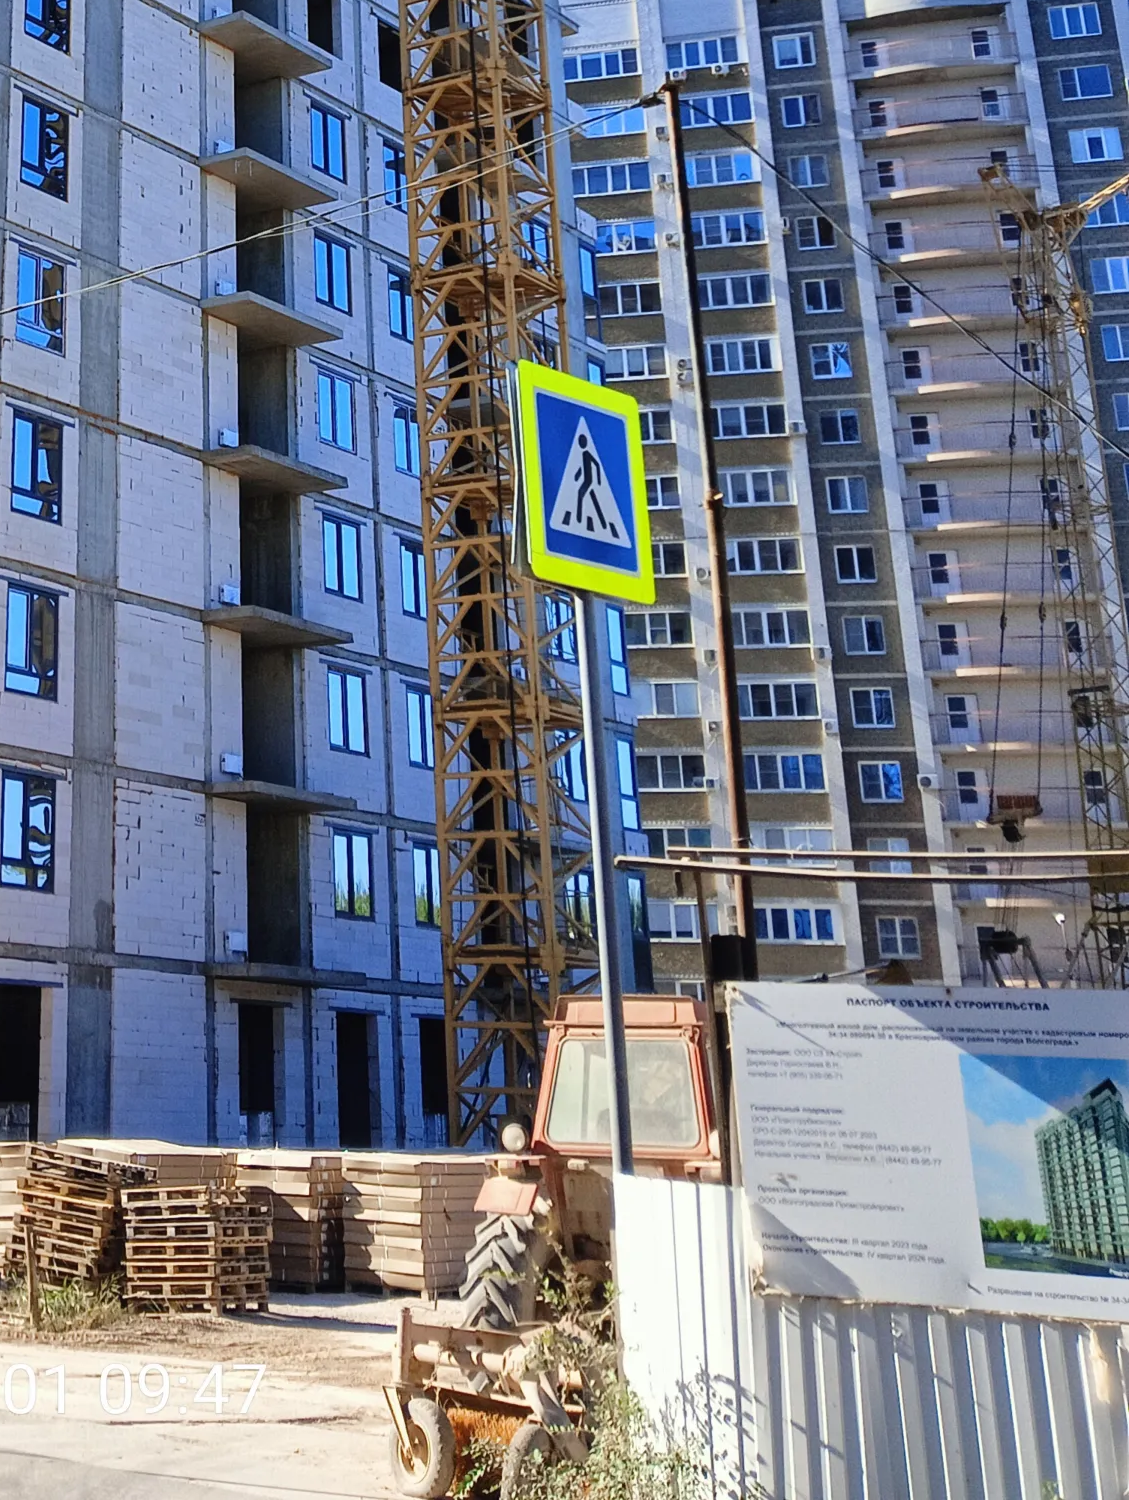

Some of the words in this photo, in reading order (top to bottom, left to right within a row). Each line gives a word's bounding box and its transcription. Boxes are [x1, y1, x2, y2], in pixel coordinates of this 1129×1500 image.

[846, 998, 897, 1008] ПАСПОРТ
[900, 998, 952, 1009] ОБЪЕКТА
[955, 1000, 1050, 1011] СТРОИТЕЛЬСТВА
[1002, 1029, 1033, 1038] участке
[1042, 1030, 1096, 1039] кадастровым
[967, 1035, 994, 1044] района
[996, 1037, 1024, 1046] города
[794, 1048, 811, 1057] ООО
[750, 1103, 800, 1113] Генеральный
[751, 1115, 769, 1124] ООО
[758, 1197, 776, 1205] ООО
[762, 1232, 789, 1241] Начало
[987, 1285, 1032, 1296] Разрешение
[1045, 1291, 1099, 1302] строительство
